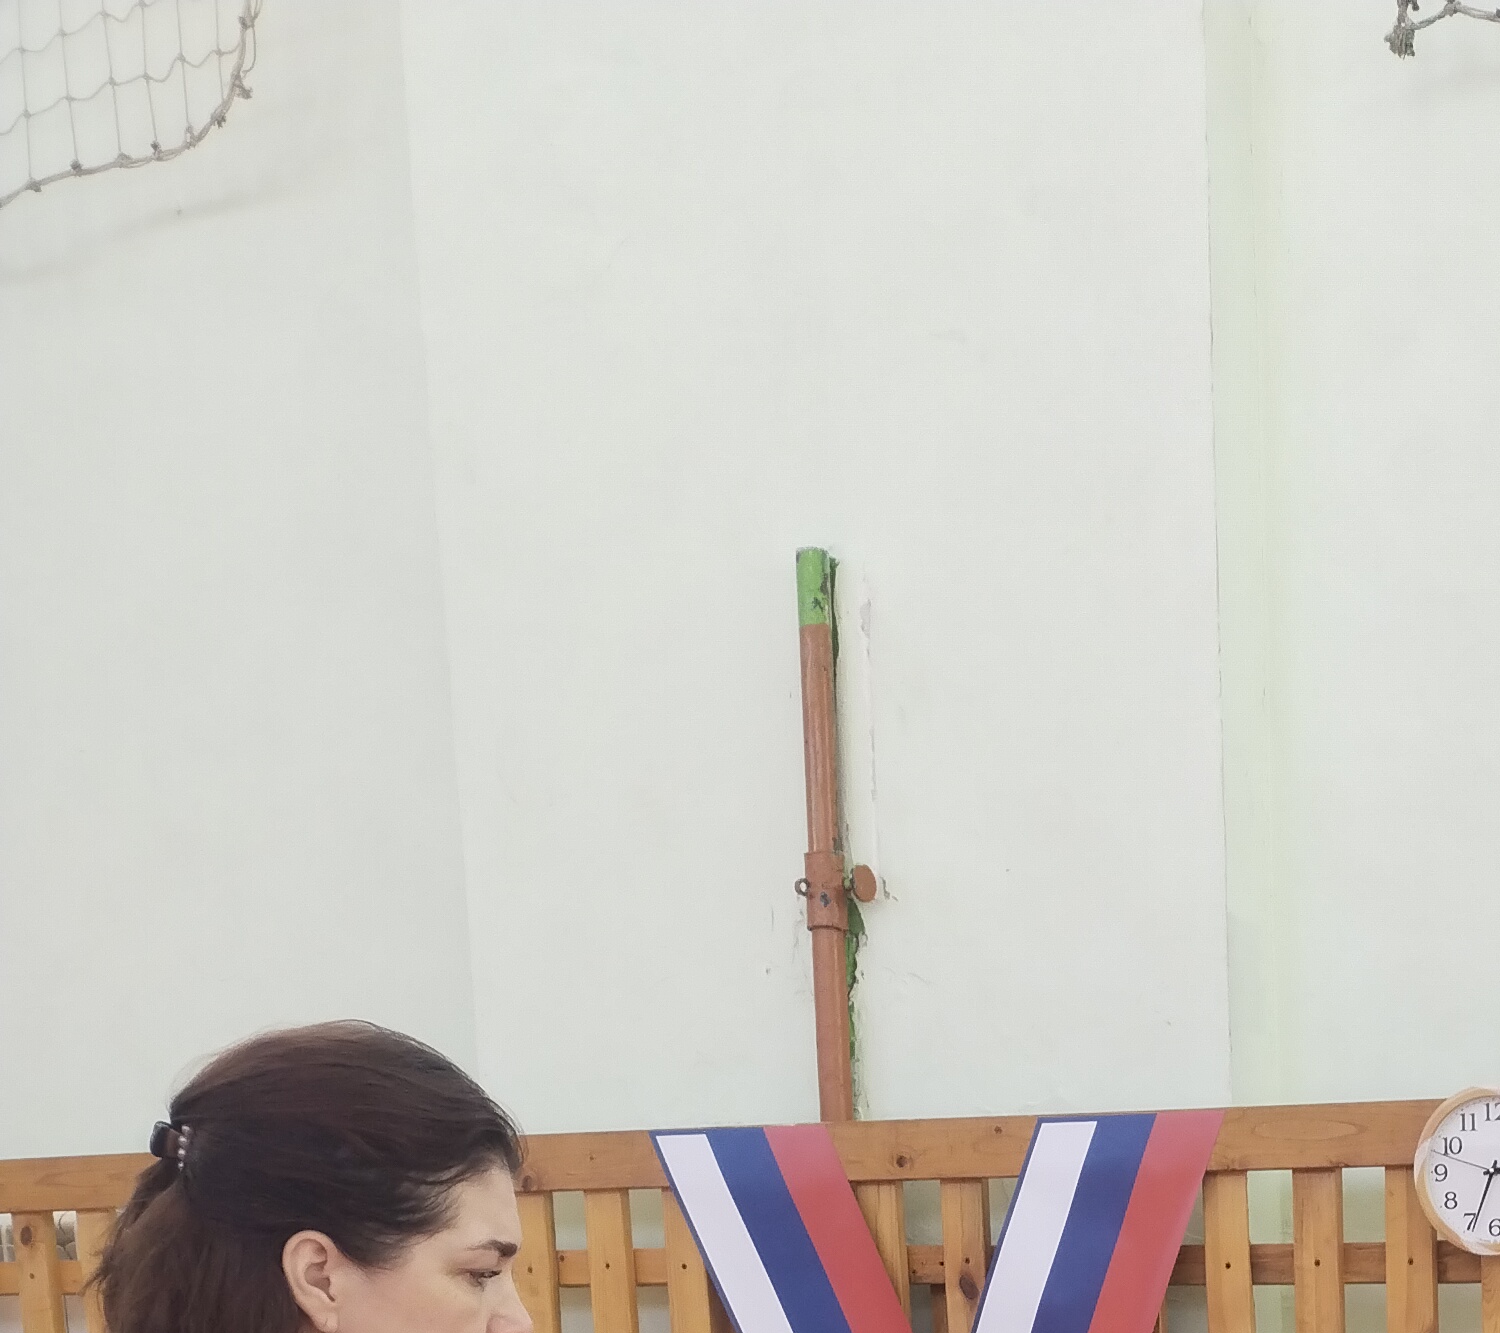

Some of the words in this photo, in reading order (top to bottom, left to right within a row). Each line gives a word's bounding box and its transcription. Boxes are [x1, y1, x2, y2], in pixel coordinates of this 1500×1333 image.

[1460, 1112, 1478, 1131] 11
[1442, 1136, 1463, 1156] 10
[1433, 1163, 1448, 1182] 9
[1444, 1191, 1458, 1209] 8
[1463, 1212, 1477, 1231] 7
